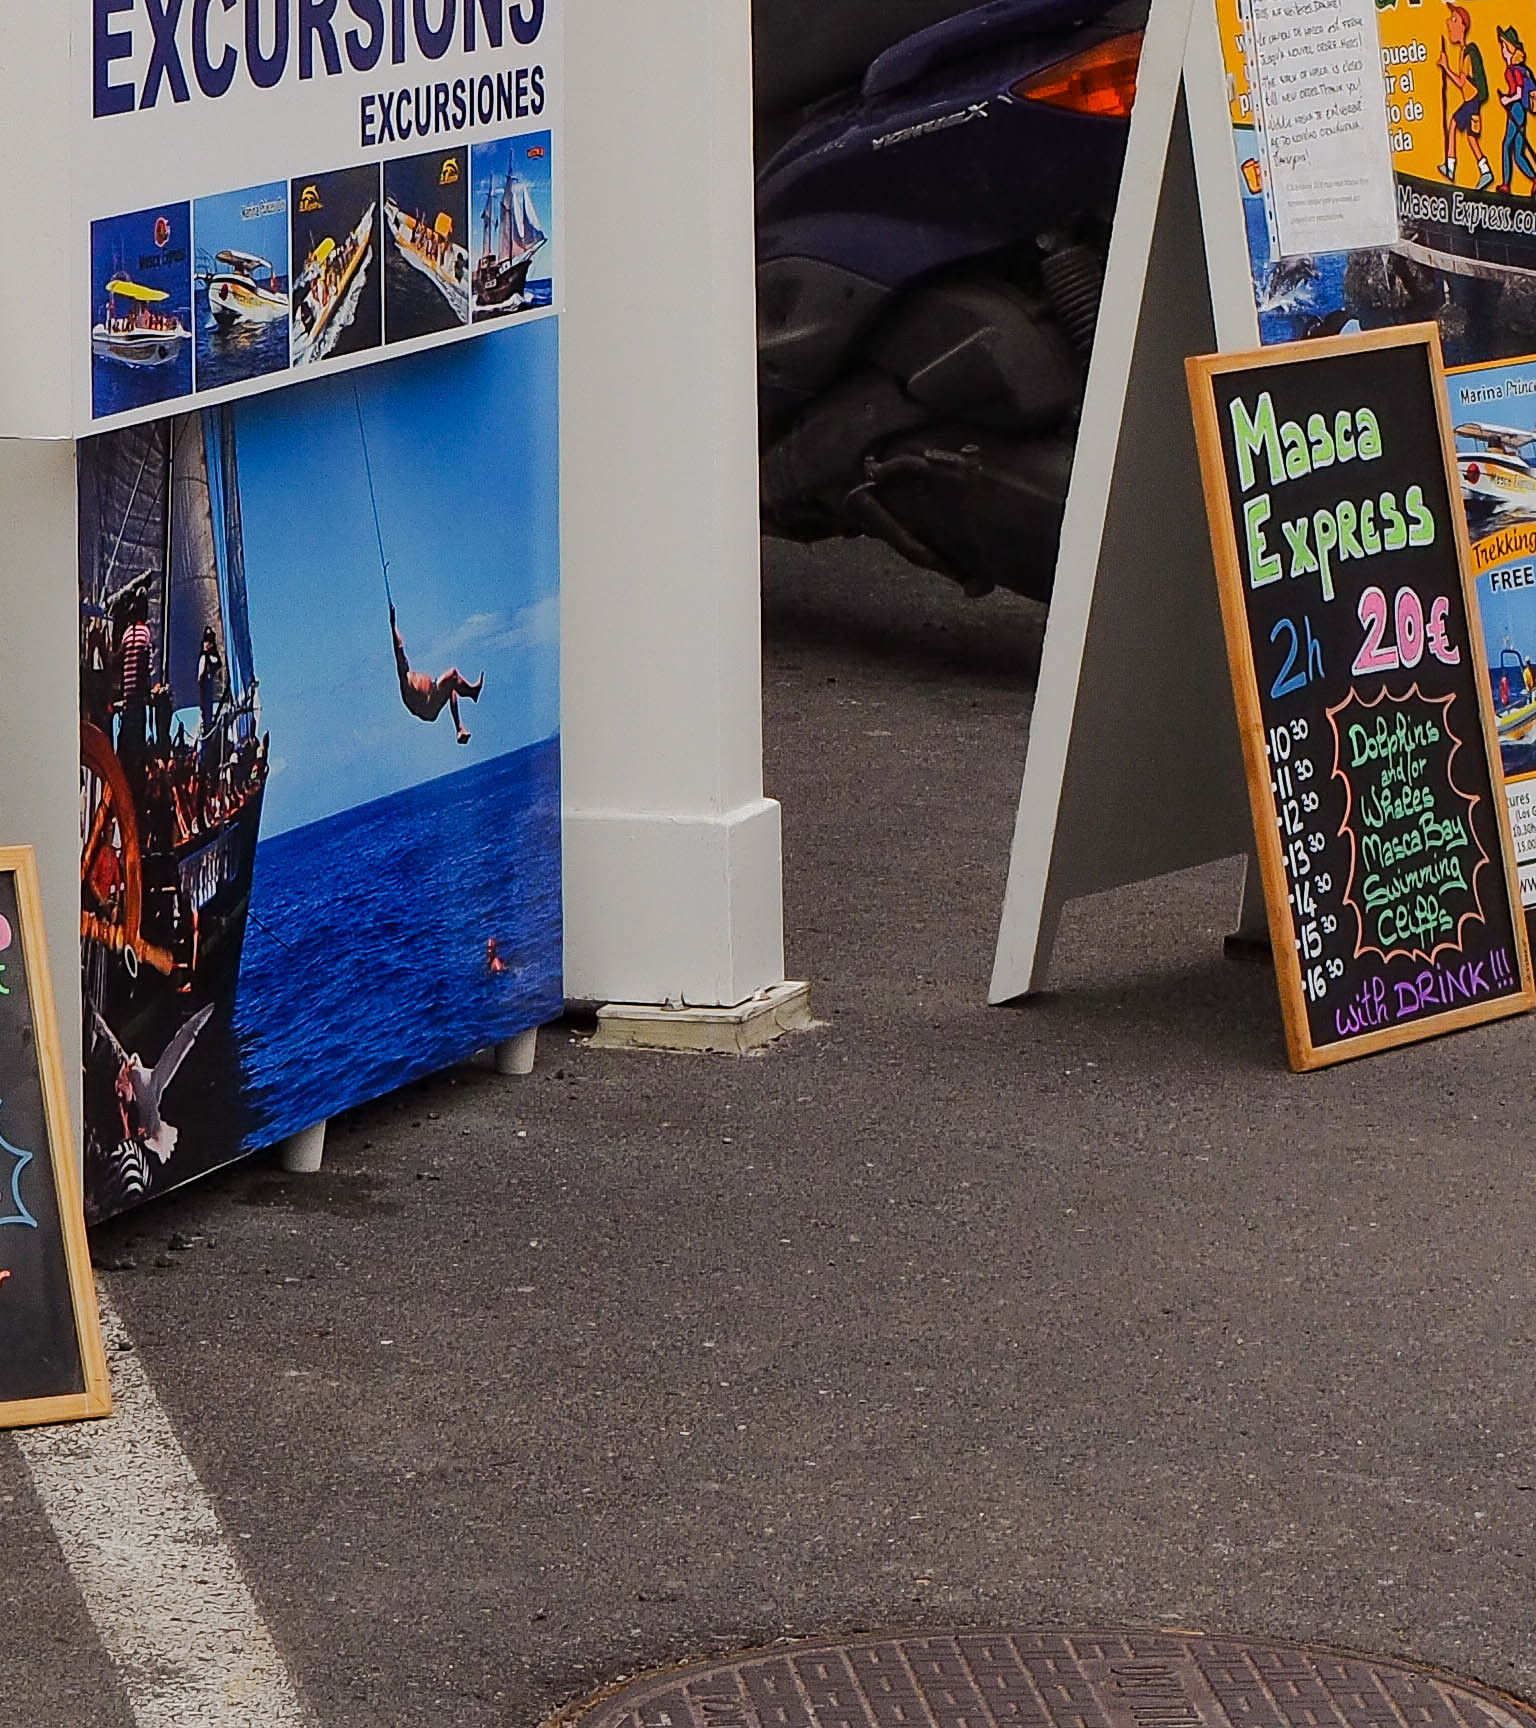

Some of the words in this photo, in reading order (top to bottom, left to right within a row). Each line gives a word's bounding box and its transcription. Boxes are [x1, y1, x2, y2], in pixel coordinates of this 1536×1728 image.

[361, 65, 545, 148] EXCURSIONES
[1398, 186, 1448, 223] Masca
[1460, 385, 1503, 405] Marina
[1230, 392, 1383, 491] Masca
[1490, 565, 1535, 592] FREE
[1268, 615, 1326, 699] 2h
[1351, 586, 1461, 677] 20€
